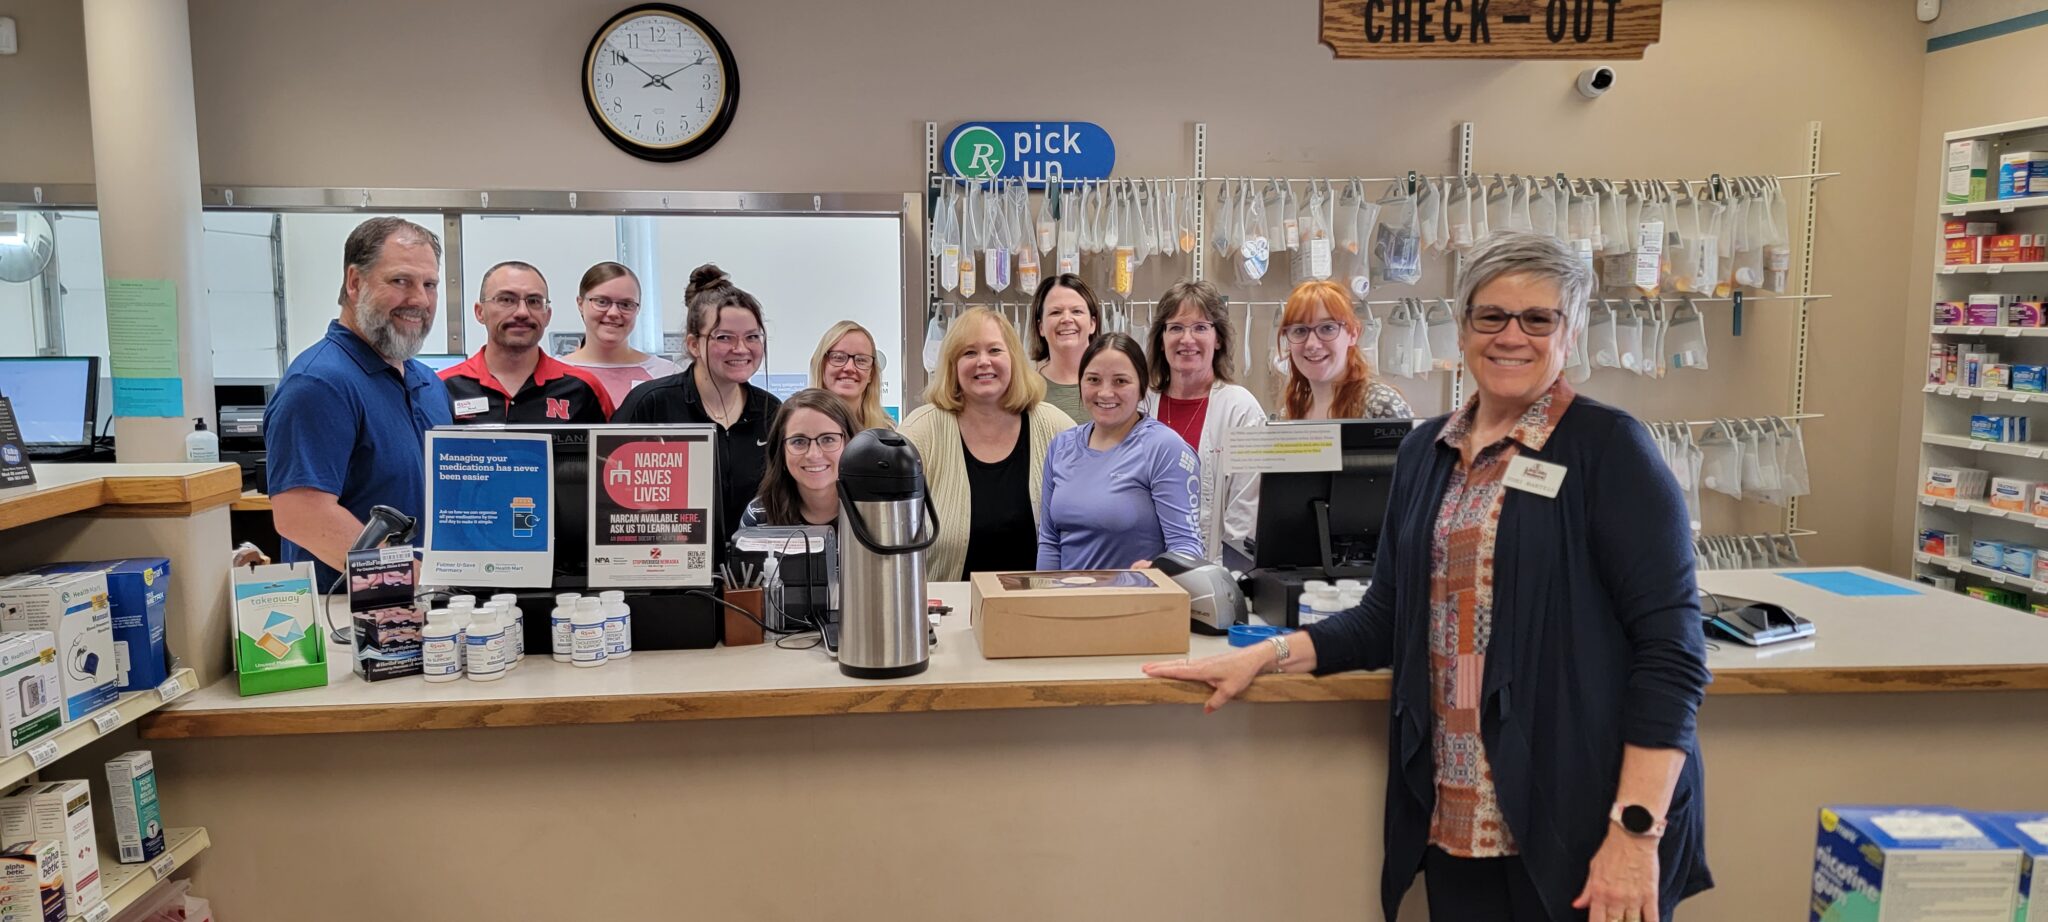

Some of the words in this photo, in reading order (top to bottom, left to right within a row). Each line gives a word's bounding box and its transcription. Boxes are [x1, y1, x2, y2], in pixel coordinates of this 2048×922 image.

[627, 34, 639, 49] 11
[650, 26, 666, 42] 12
[676, 32, 682, 48] 1
[610, 50, 626, 66] 10
[605, 73, 614, 89] 9
[702, 74, 711, 90] 3
[614, 96, 622, 113] 8
[696, 97, 705, 112] 4
[634, 114, 642, 130] 7
[656, 120, 664, 136] 6
[680, 115, 688, 130] 5
[1014, 124, 1082, 162] pick
[546, 398, 570, 420] N
[440, 454, 485, 463] Managing
[635, 452, 682, 468] NARCAN
[440, 463, 494, 471] medications
[440, 472, 461, 480] been
[462, 472, 489, 481] easier
[634, 470, 672, 485] SAVES
[634, 487, 670, 502] LIVES!
[610, 514, 639, 523] NARCAN
[641, 514, 678, 523] AVAILABLE
[680, 514, 700, 522] HERE.
[610, 524, 624, 533] ASK
[626, 524, 635, 533] US
[637, 524, 646, 533] TO
[647, 524, 670, 533] LEARN
[672, 524, 692, 533] MORE
[251, 594, 300, 606] takeaway
[41, 850, 59, 869] alpha
[42, 861, 60, 878] betic
[1816, 845, 1880, 902] nicotine
[1814, 873, 1848, 906] gum
